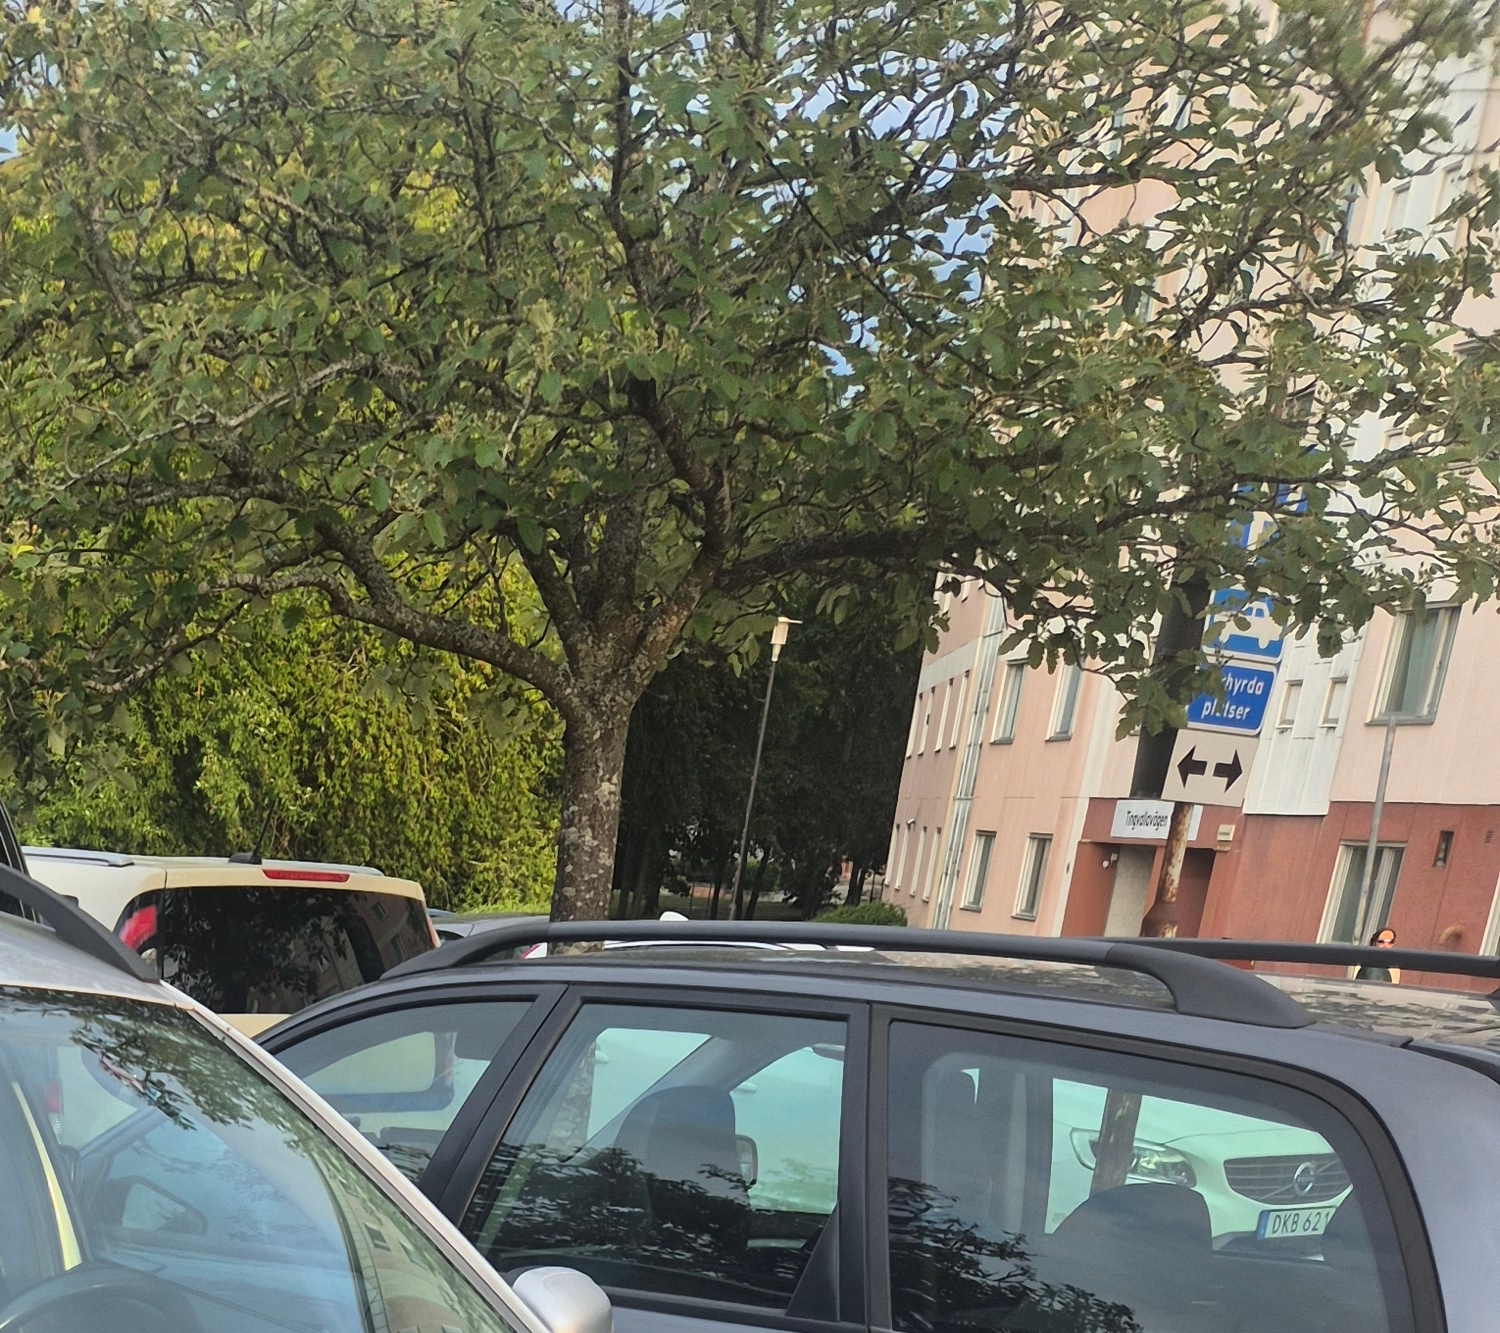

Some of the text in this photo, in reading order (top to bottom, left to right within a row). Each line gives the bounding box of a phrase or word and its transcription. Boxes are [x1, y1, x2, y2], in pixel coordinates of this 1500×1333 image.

[1222, 672, 1265, 696] hyrda
[1272, 1211, 1331, 1234] DKB 621
